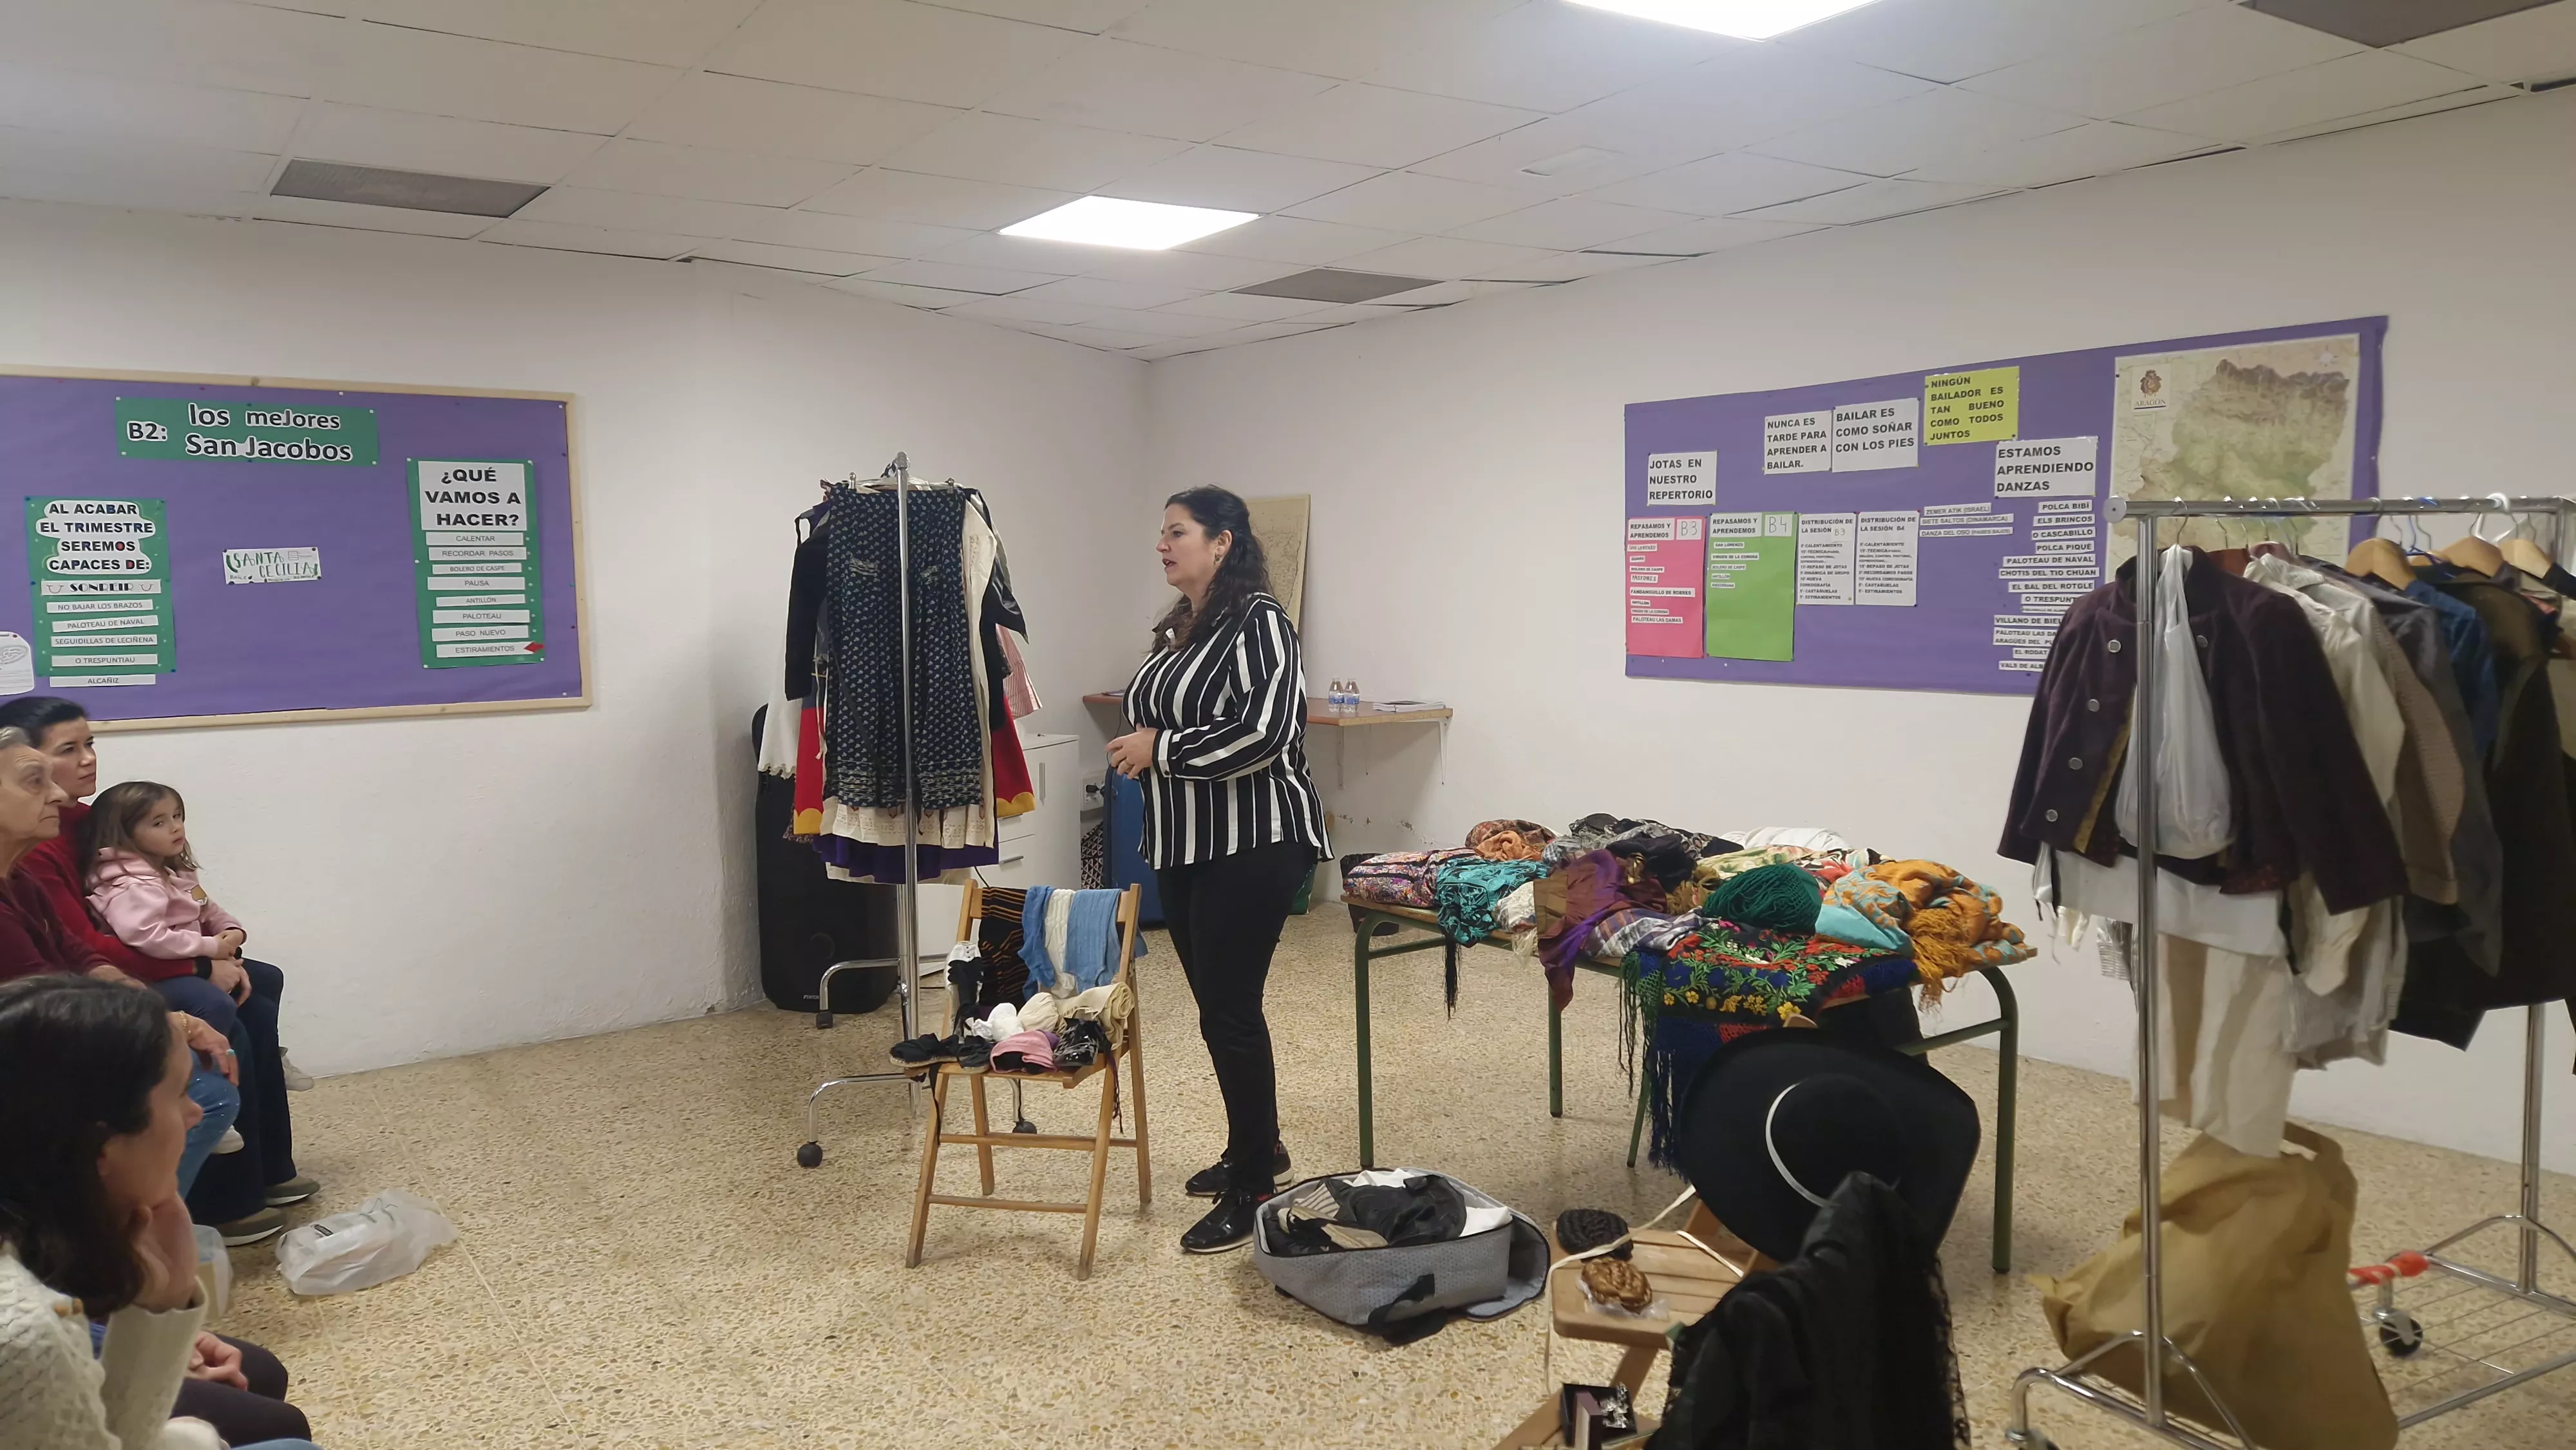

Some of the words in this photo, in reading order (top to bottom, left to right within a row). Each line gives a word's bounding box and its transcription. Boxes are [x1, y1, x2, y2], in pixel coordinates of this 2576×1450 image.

[1931, 376, 1971, 388] NINGÚN
[1931, 389, 1981, 401] BAILADOR
[1991, 386, 2003, 395] ES
[1931, 406, 1950, 414] TAN
[1969, 400, 2004, 410] BUENO
[189, 404, 229, 426] los
[1836, 410, 1877, 422] BAILAR
[1880, 408, 1895, 418] ES
[1930, 418, 1960, 427] COMO
[1969, 413, 2003, 424] TODOS
[1767, 419, 1800, 429] NUNCA
[1803, 417, 1815, 426] ES
[128, 422, 167, 440] B2:
[1836, 426, 1868, 437] COMO
[1872, 422, 1912, 433] SOÑAR
[1930, 430, 1970, 440] JUNTOS
[1767, 433, 1797, 442] TARDE
[1801, 430, 1827, 440] PARA
[186, 433, 237, 455] San
[245, 436, 352, 460] Jacobos
[1767, 445, 1817, 456] APRENDER
[1835, 443, 1859, 453] CON
[1862, 440, 1884, 451] LOS
[1888, 437, 1914, 448] PIES
[1998, 446, 2061, 458] ESTAMOS
[1649, 460, 1682, 469] JOTAS
[1688, 458, 1702, 467] EN
[1767, 460, 1803, 469] BAILAR.
[1997, 462, 2094, 475] APRENDIENDO
[441, 467, 497, 484] ¿QUÉ
[1649, 475, 1697, 484] NUESTRO
[1997, 481, 2050, 492] DANZAS
[424, 491, 500, 504] VAMOS
[507, 492, 521, 504] A
[1649, 490, 1713, 500] REPERTORIO
[49, 504, 69, 514] AL
[74, 504, 137, 514] ACABAR
[437, 514, 519, 526] HACER?
[40, 522, 59, 532] EL
[64, 523, 153, 533] TRIMESTRE
[2041, 529, 2093, 538] CASCABILLO
[61, 541, 135, 551] SEREMOS
[50, 560, 120, 570] CAPACES
[126, 560, 149, 570] DE:
[234, 552, 284, 568] SANTA
[70, 583, 133, 592] SONREIR
[67, 621, 106, 629] PALOTEAU
